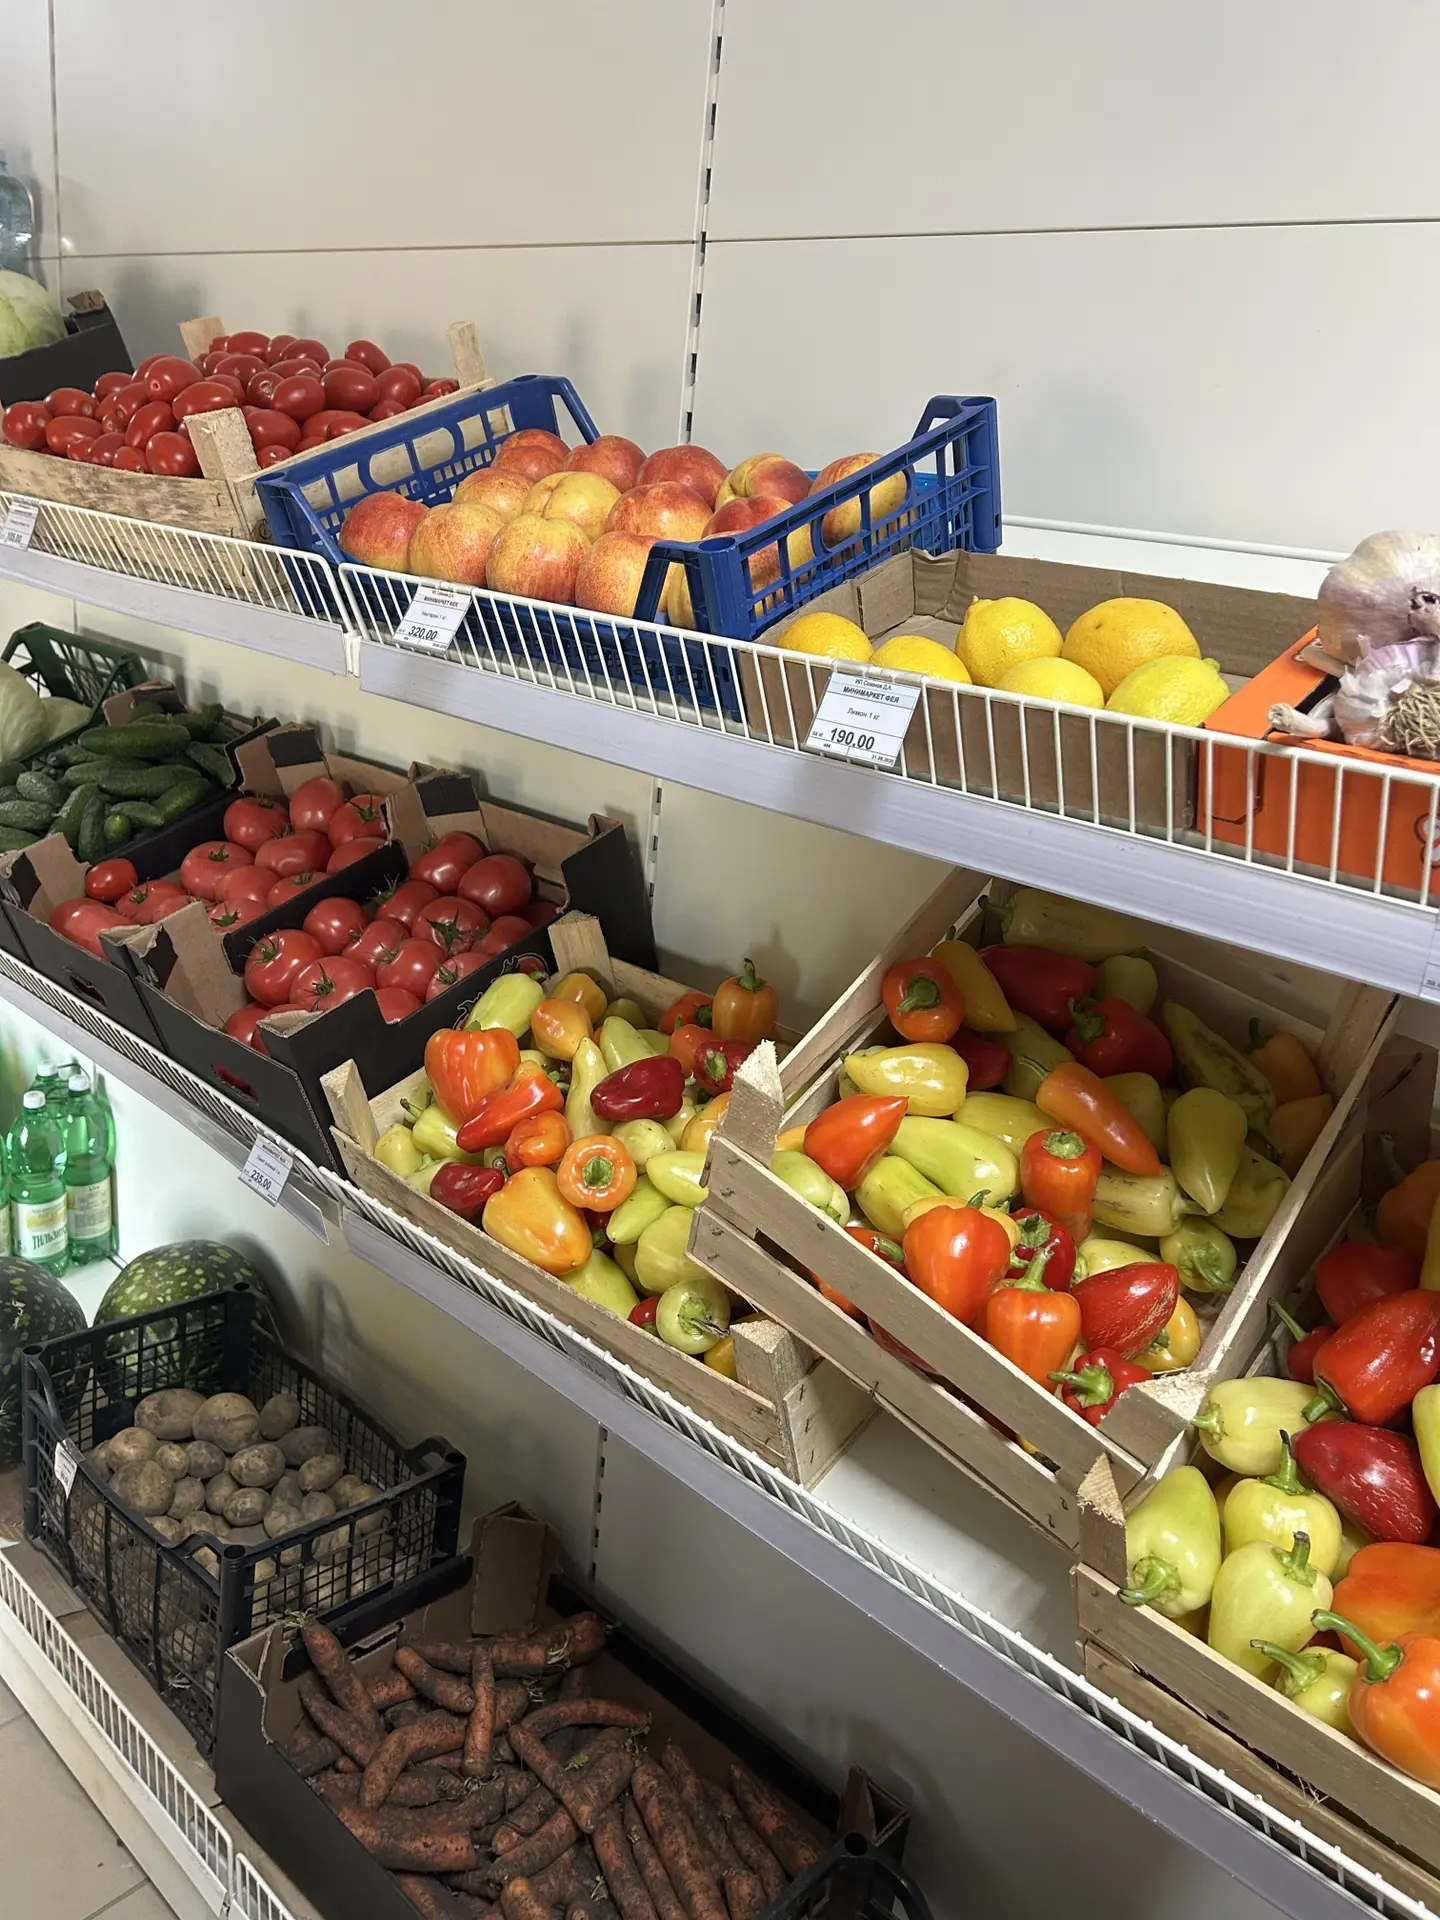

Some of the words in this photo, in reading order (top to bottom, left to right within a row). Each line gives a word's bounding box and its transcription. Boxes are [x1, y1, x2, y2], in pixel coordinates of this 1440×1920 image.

[843, 686, 884, 701] МИНИМАРКЕТ
[885, 695, 900, 704] ФЕЯ
[847, 707, 867, 718] Лимон
